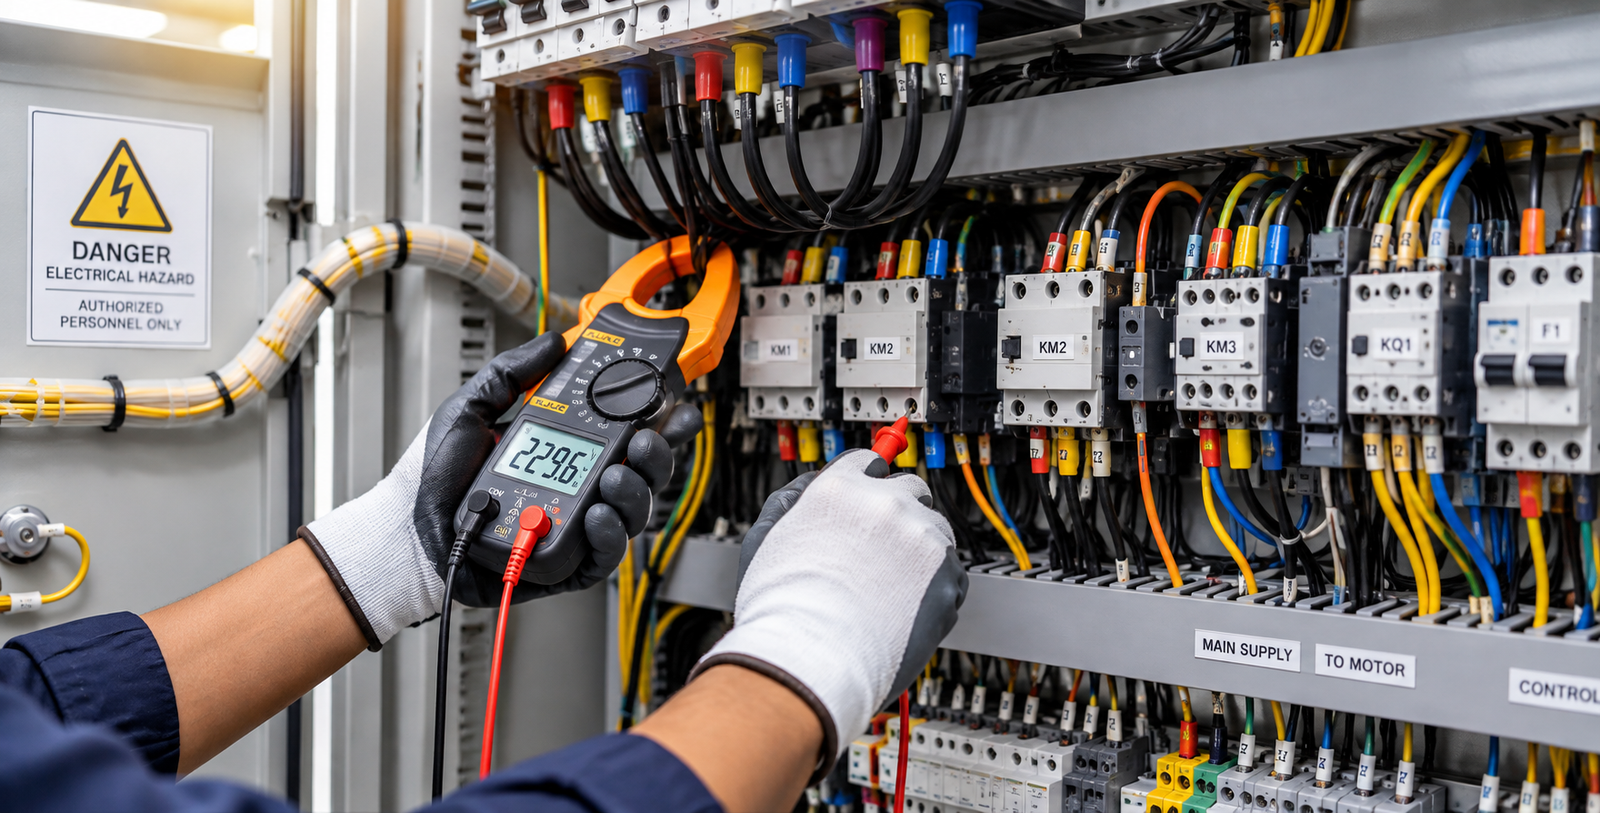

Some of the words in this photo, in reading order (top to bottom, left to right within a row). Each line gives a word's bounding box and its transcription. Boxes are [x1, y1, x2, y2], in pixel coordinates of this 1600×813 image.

[72, 240, 171, 265] DANGER
[46, 266, 134, 283] ELECTRICAL
[138, 271, 195, 286] HAZARD
[78, 299, 164, 315] AUTHORIZED
[60, 315, 143, 330] PERSONNEL
[147, 318, 182, 331] ONLY
[1542, 323, 1559, 339] F1
[770, 343, 791, 356] KM1
[869, 342, 894, 355] KM2
[1038, 340, 1067, 354] KM2
[1206, 340, 1237, 354] KM3
[1380, 337, 1412, 353] KQ1
[1202, 638, 1236, 655] MAIN
[1240, 643, 1293, 662] SUPPLY
[1324, 653, 1345, 668] TO
[1349, 657, 1406, 677] MOTOR
[1519, 679, 1600, 704] CONTROL
